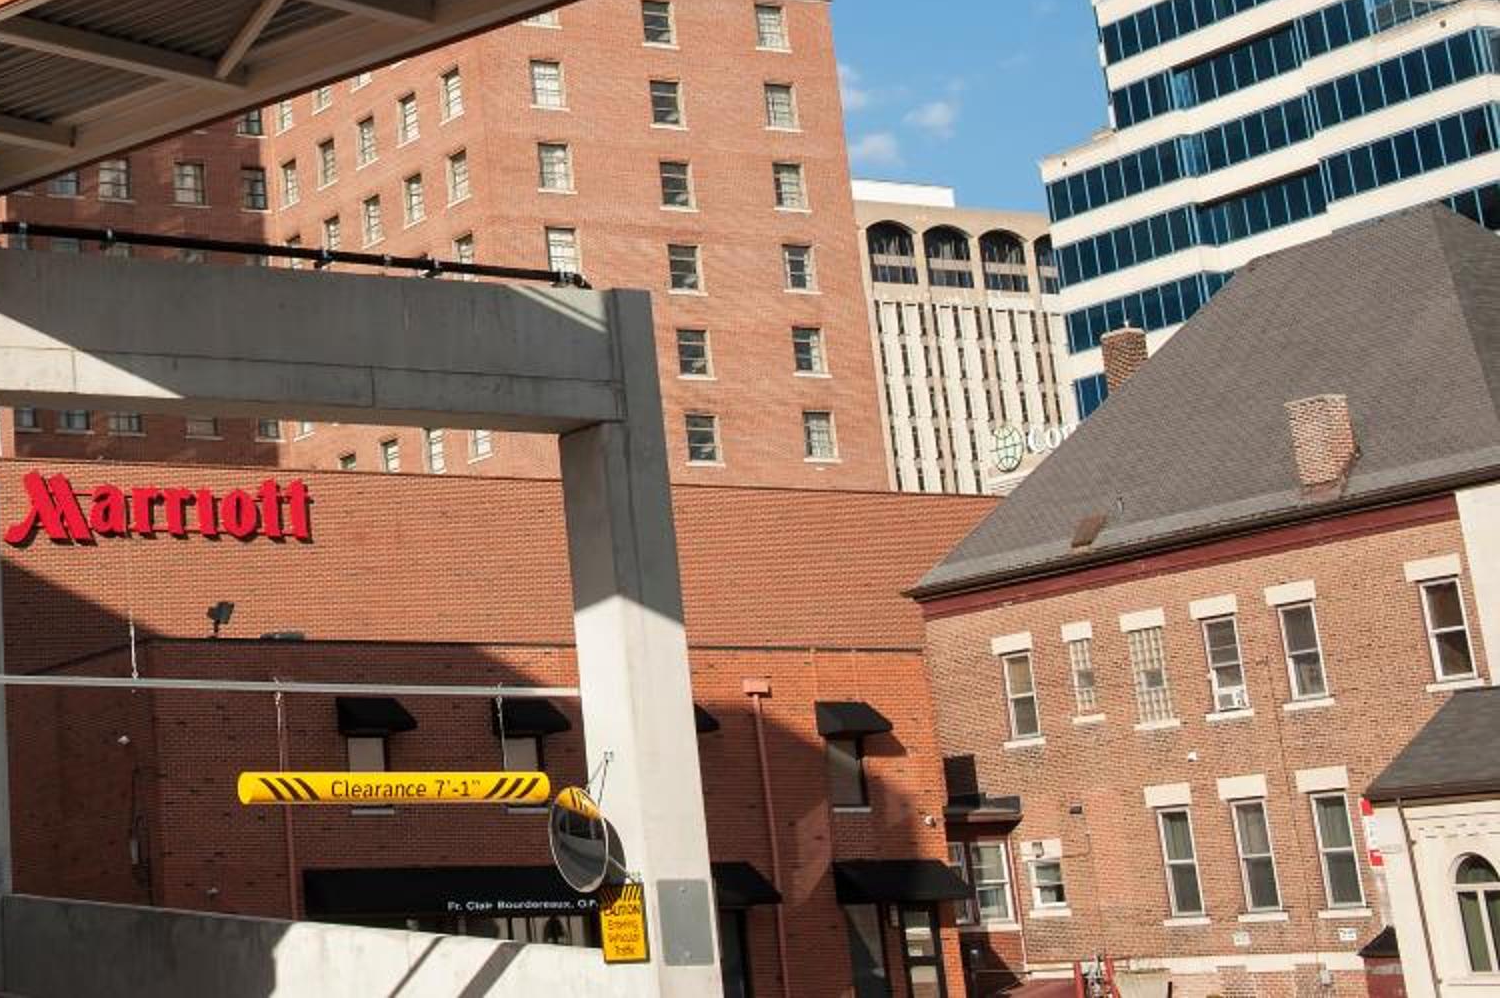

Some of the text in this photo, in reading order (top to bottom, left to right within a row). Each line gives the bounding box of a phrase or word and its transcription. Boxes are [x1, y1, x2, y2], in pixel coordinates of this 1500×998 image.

[3, 469, 310, 544] Marriott
[331, 779, 427, 797] Clearance
[604, 904, 641, 916] CAUTION
